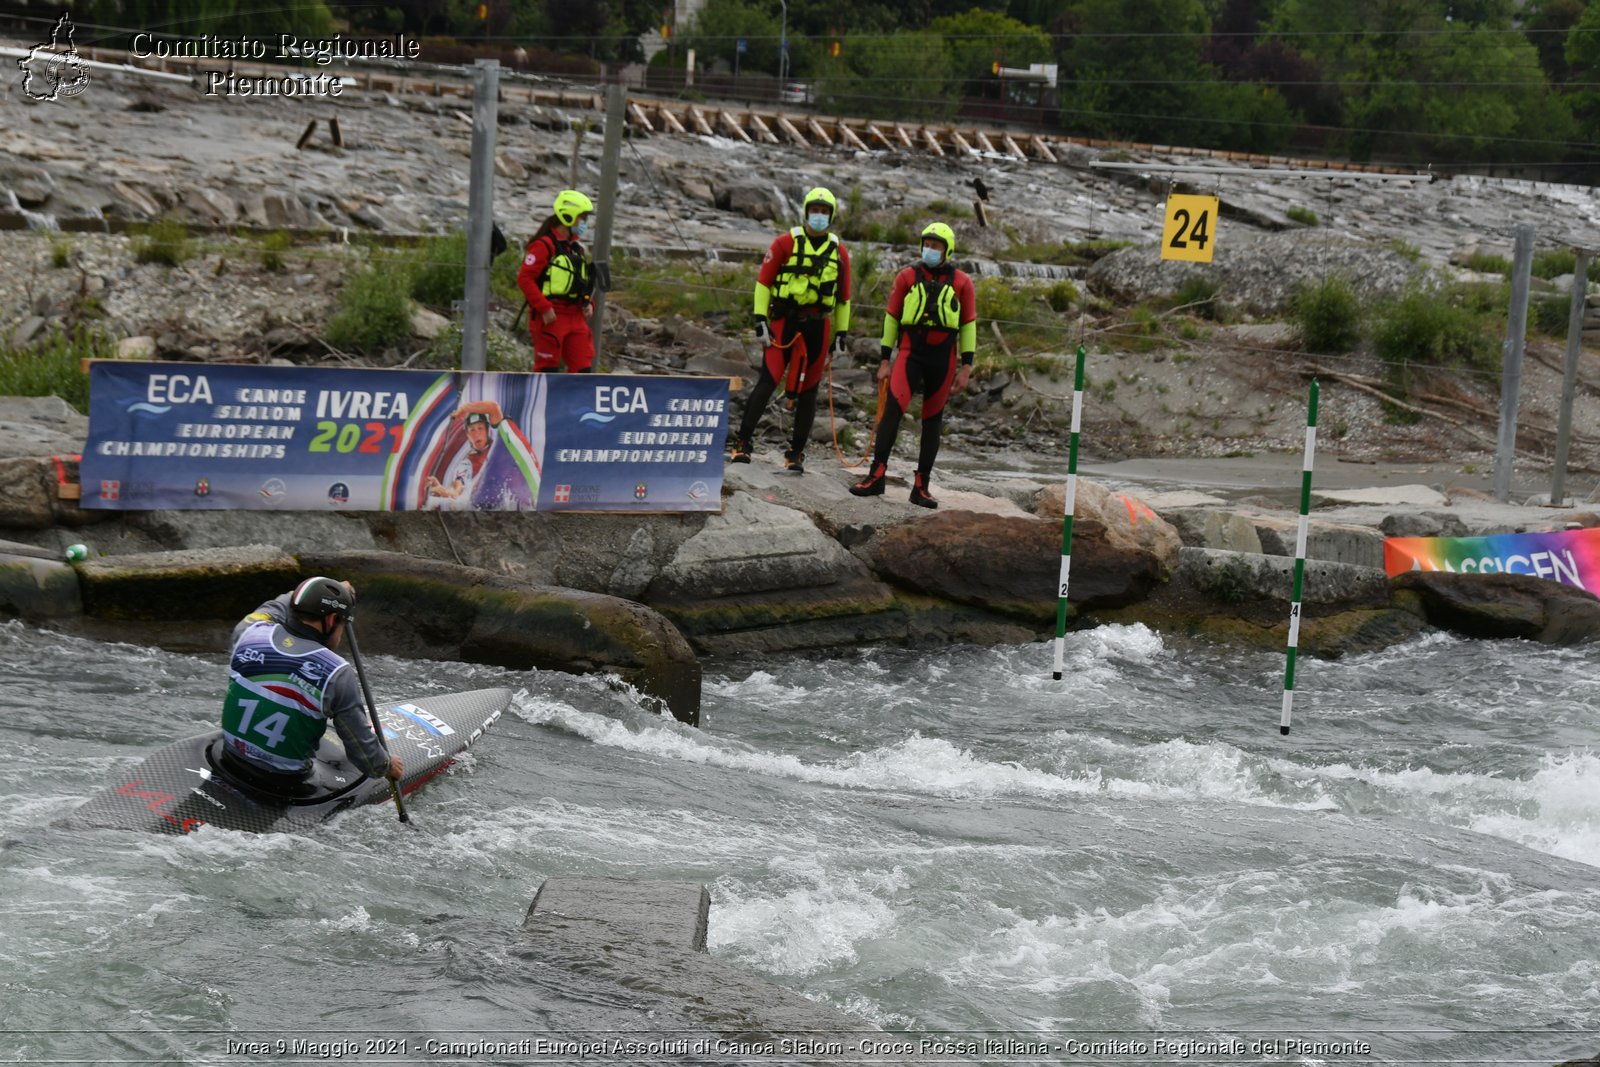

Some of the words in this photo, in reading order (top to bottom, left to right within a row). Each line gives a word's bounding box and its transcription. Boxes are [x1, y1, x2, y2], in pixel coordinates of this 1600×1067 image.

[1170, 209, 1208, 250] 24
[147, 374, 214, 404] ECA
[236, 388, 307, 404] CANOE
[316, 390, 409, 420] IVREA
[595, 386, 649, 413] ECA
[668, 398, 725, 412] CANOE
[216, 405, 301, 421] SLALOM
[651, 414, 719, 428] SLALOM
[180, 423, 295, 439] EUROPEAN
[308, 421, 404, 454] 2021
[621, 432, 713, 446] EUROPEAN
[100, 441, 287, 459] CHAMPIONSHIPS
[558, 449, 708, 463] CHAMPIONSHIPS
[1061, 583, 1067, 595] 2
[1292, 605, 1298, 617] 4
[243, 648, 265, 664] ECA
[237, 698, 290, 748] 14
[414, 707, 446, 728] ITA
